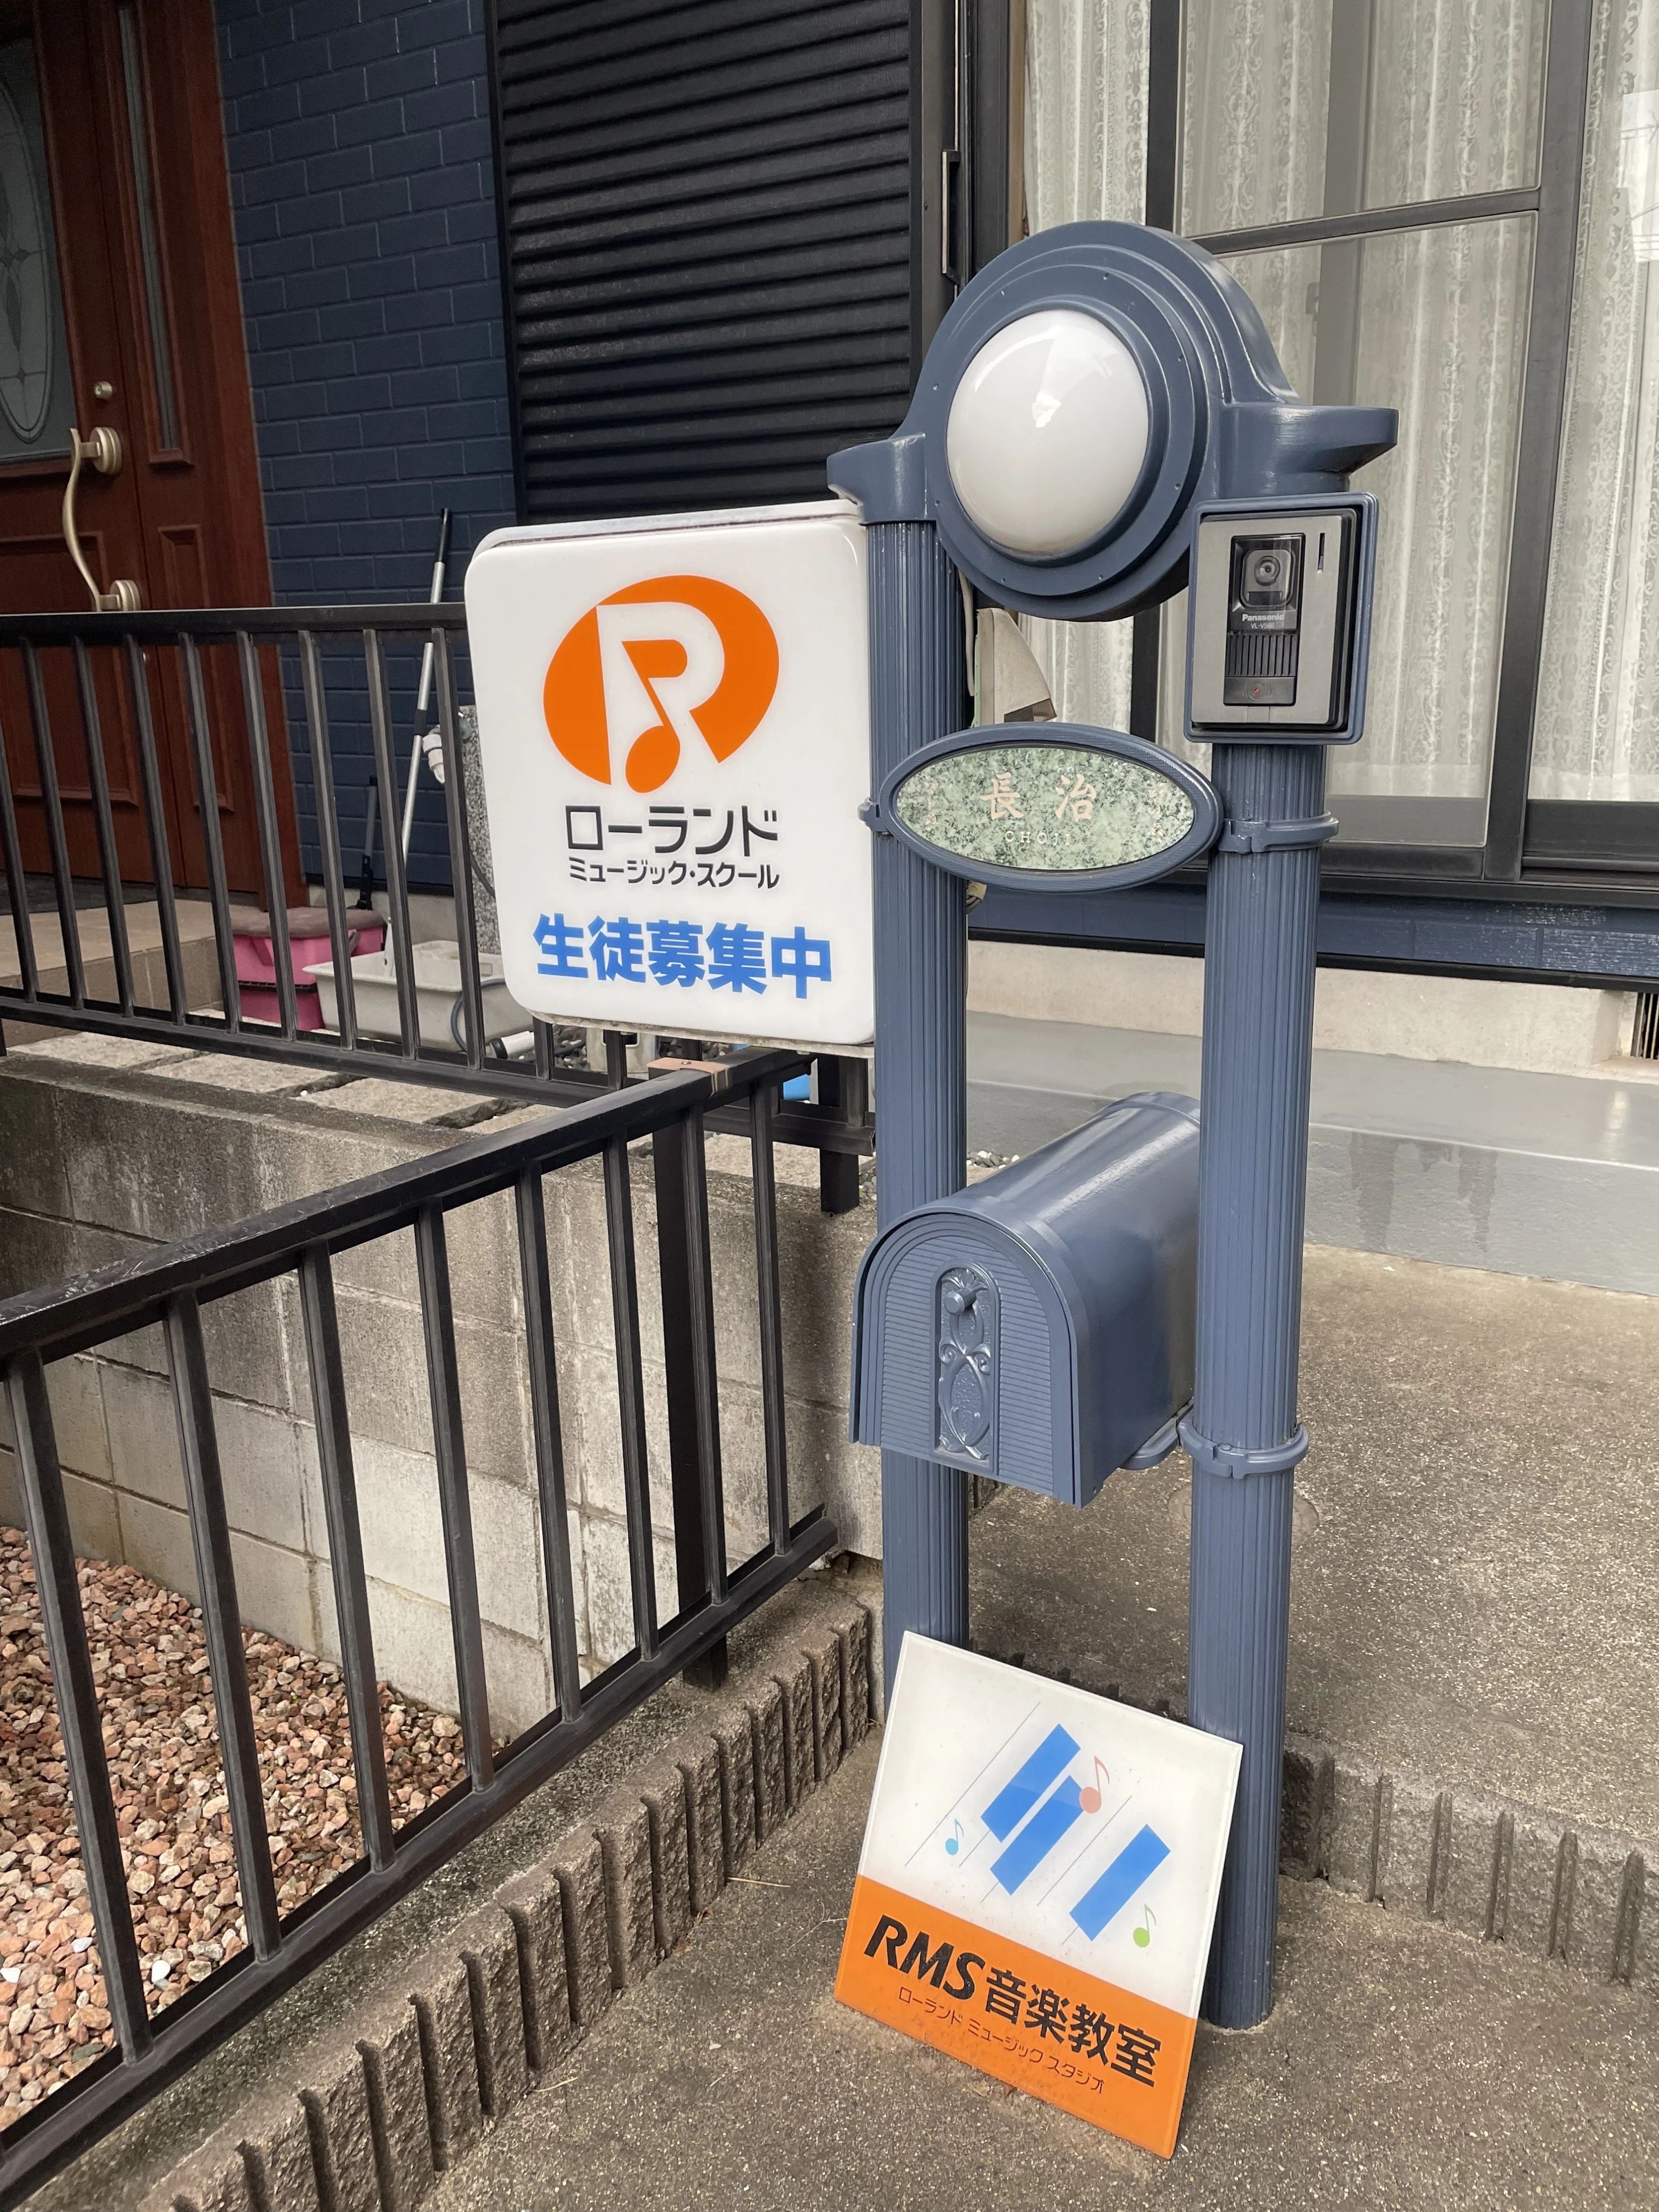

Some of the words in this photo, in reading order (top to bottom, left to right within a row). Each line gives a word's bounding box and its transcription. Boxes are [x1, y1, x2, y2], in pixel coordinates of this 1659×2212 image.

[565, 805, 779, 857] ローランド
[1005, 831, 1071, 846] CHOJI
[568, 857, 780, 889] ミュージック・スクール
[533, 912, 832, 999] 生徒募集中
[863, 1913, 1161, 2088] RMS音楽教室
[898, 1986, 963, 2025] ローランド
[967, 2019, 1043, 2063] ミュージック
[1048, 2056, 1105, 2094] スタジオ
